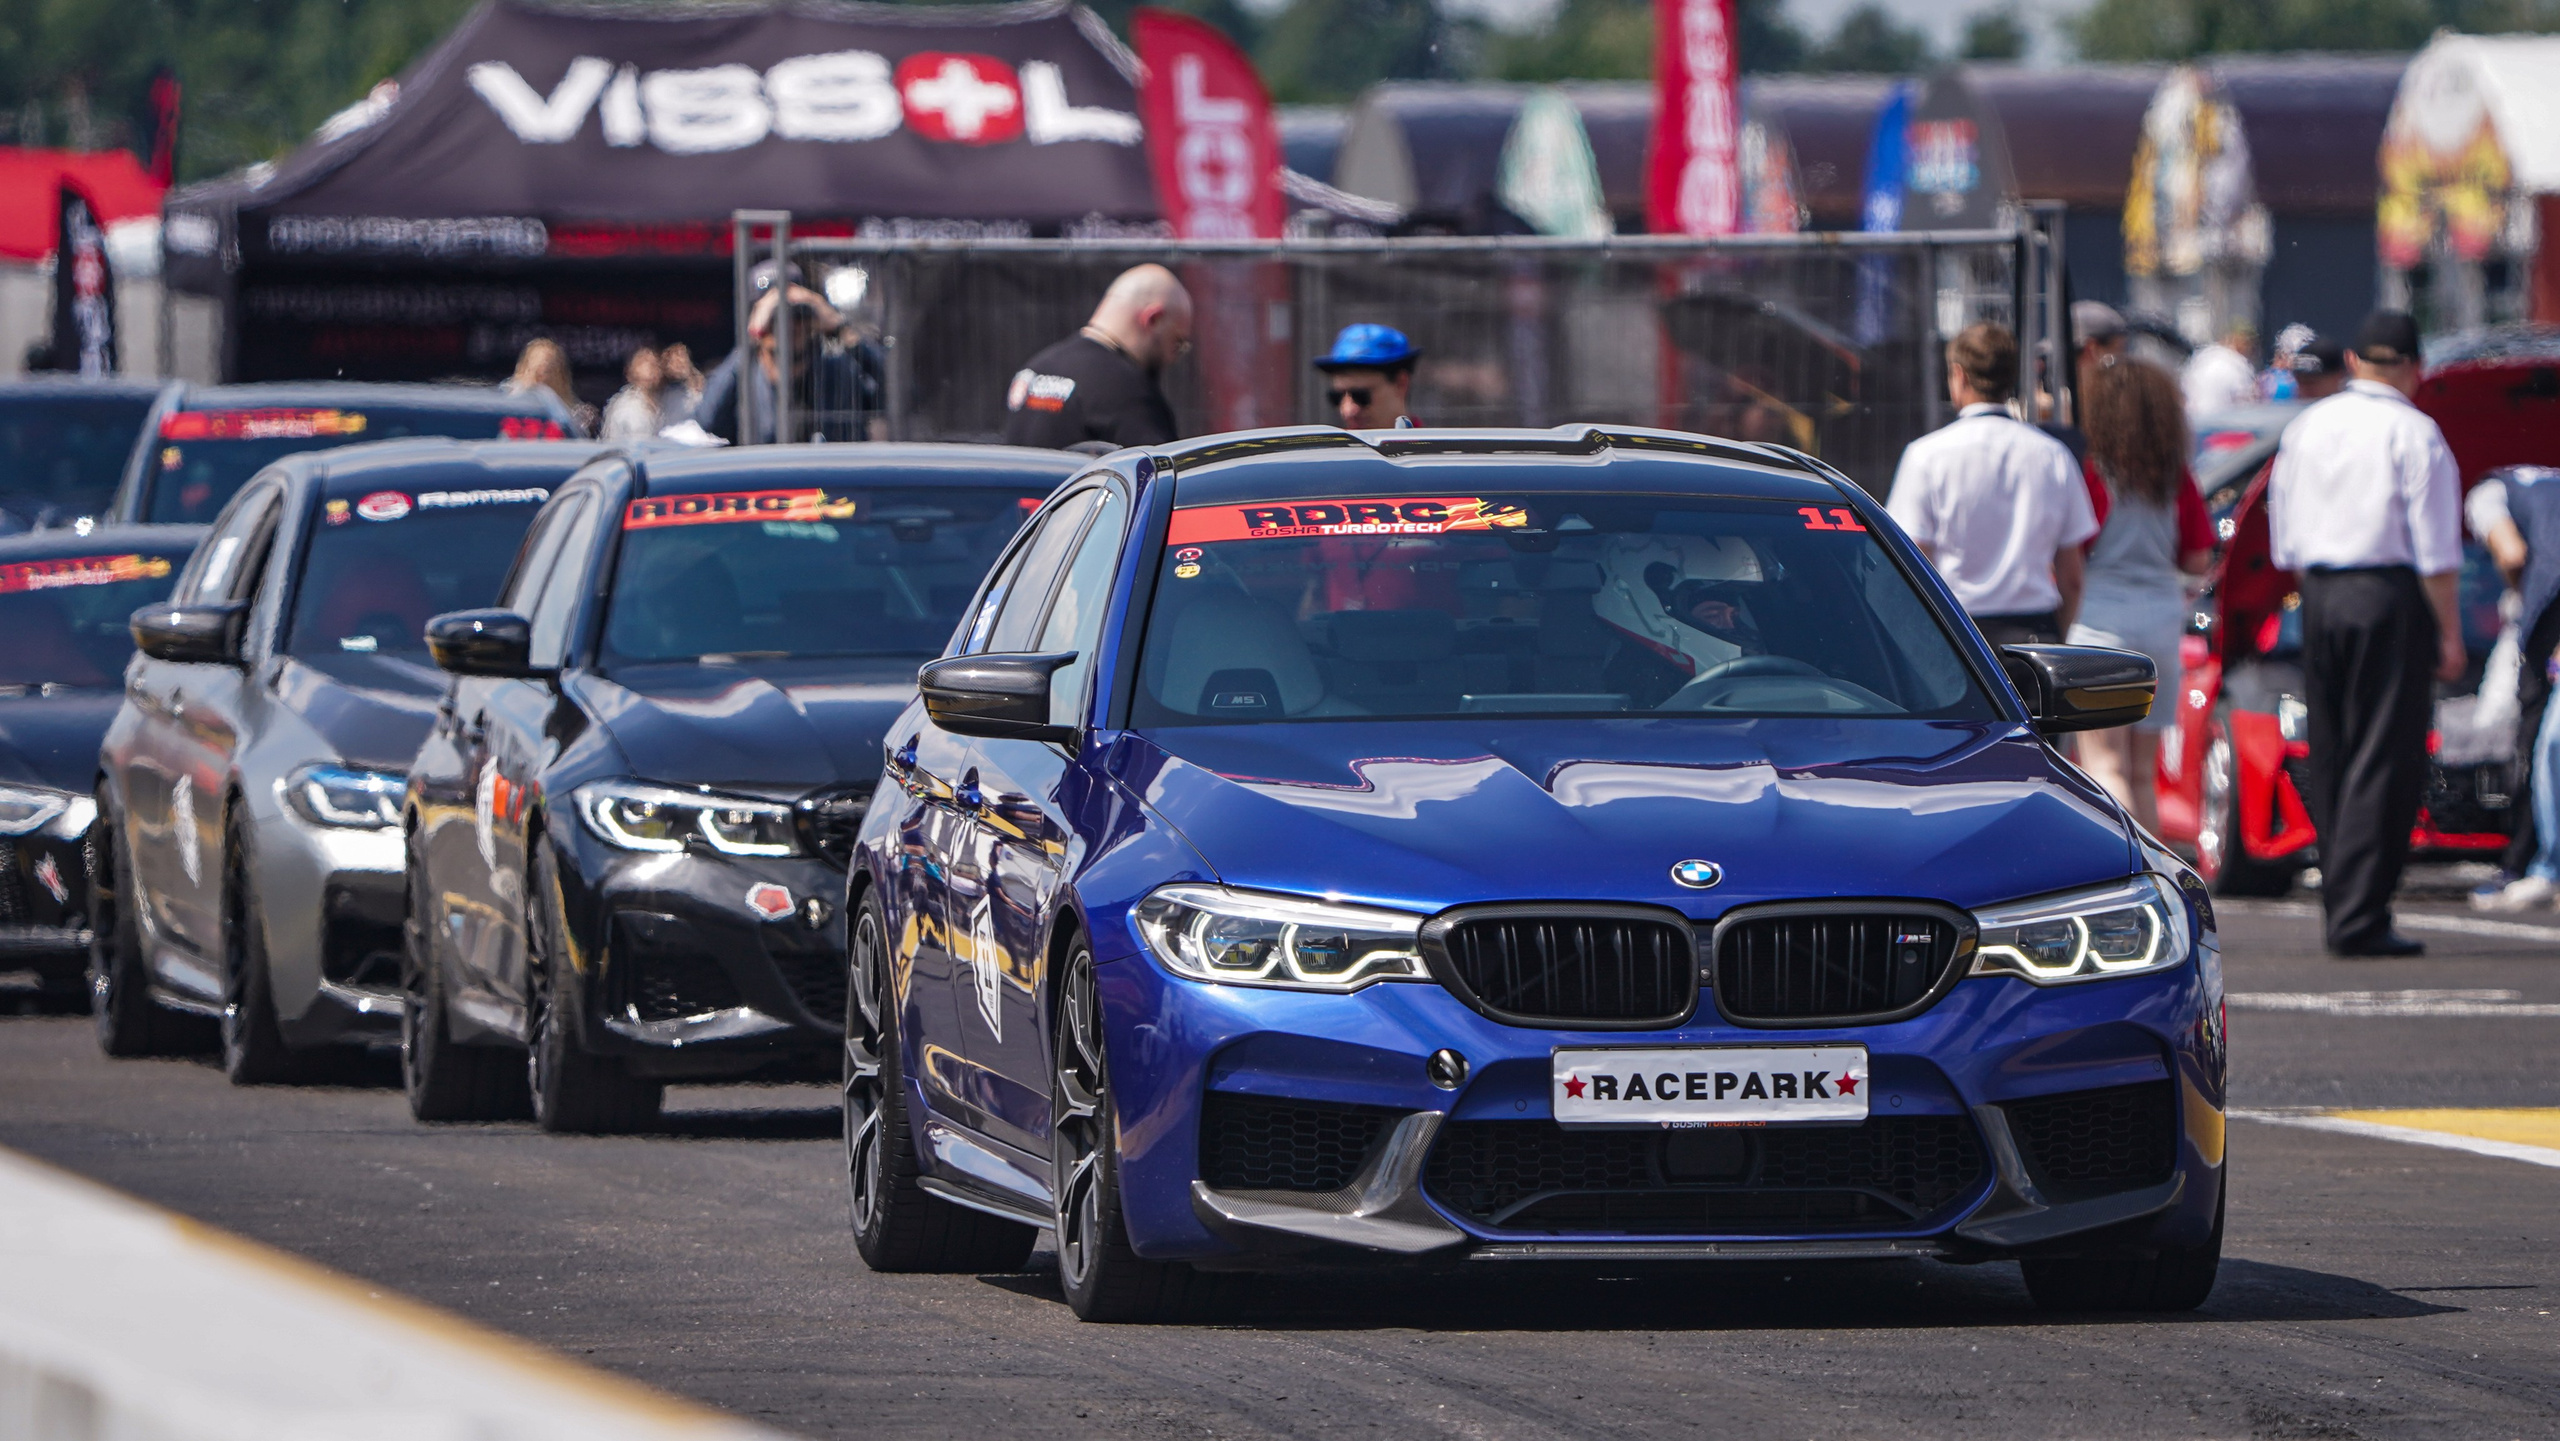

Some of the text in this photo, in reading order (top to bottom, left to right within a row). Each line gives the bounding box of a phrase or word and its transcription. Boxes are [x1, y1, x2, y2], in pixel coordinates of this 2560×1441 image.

[1239, 502, 1449, 529] RDRC
[1798, 507, 1867, 532] 11
[1898, 934, 1931, 943] M5
[1592, 1071, 1831, 1100] RACEPARK
